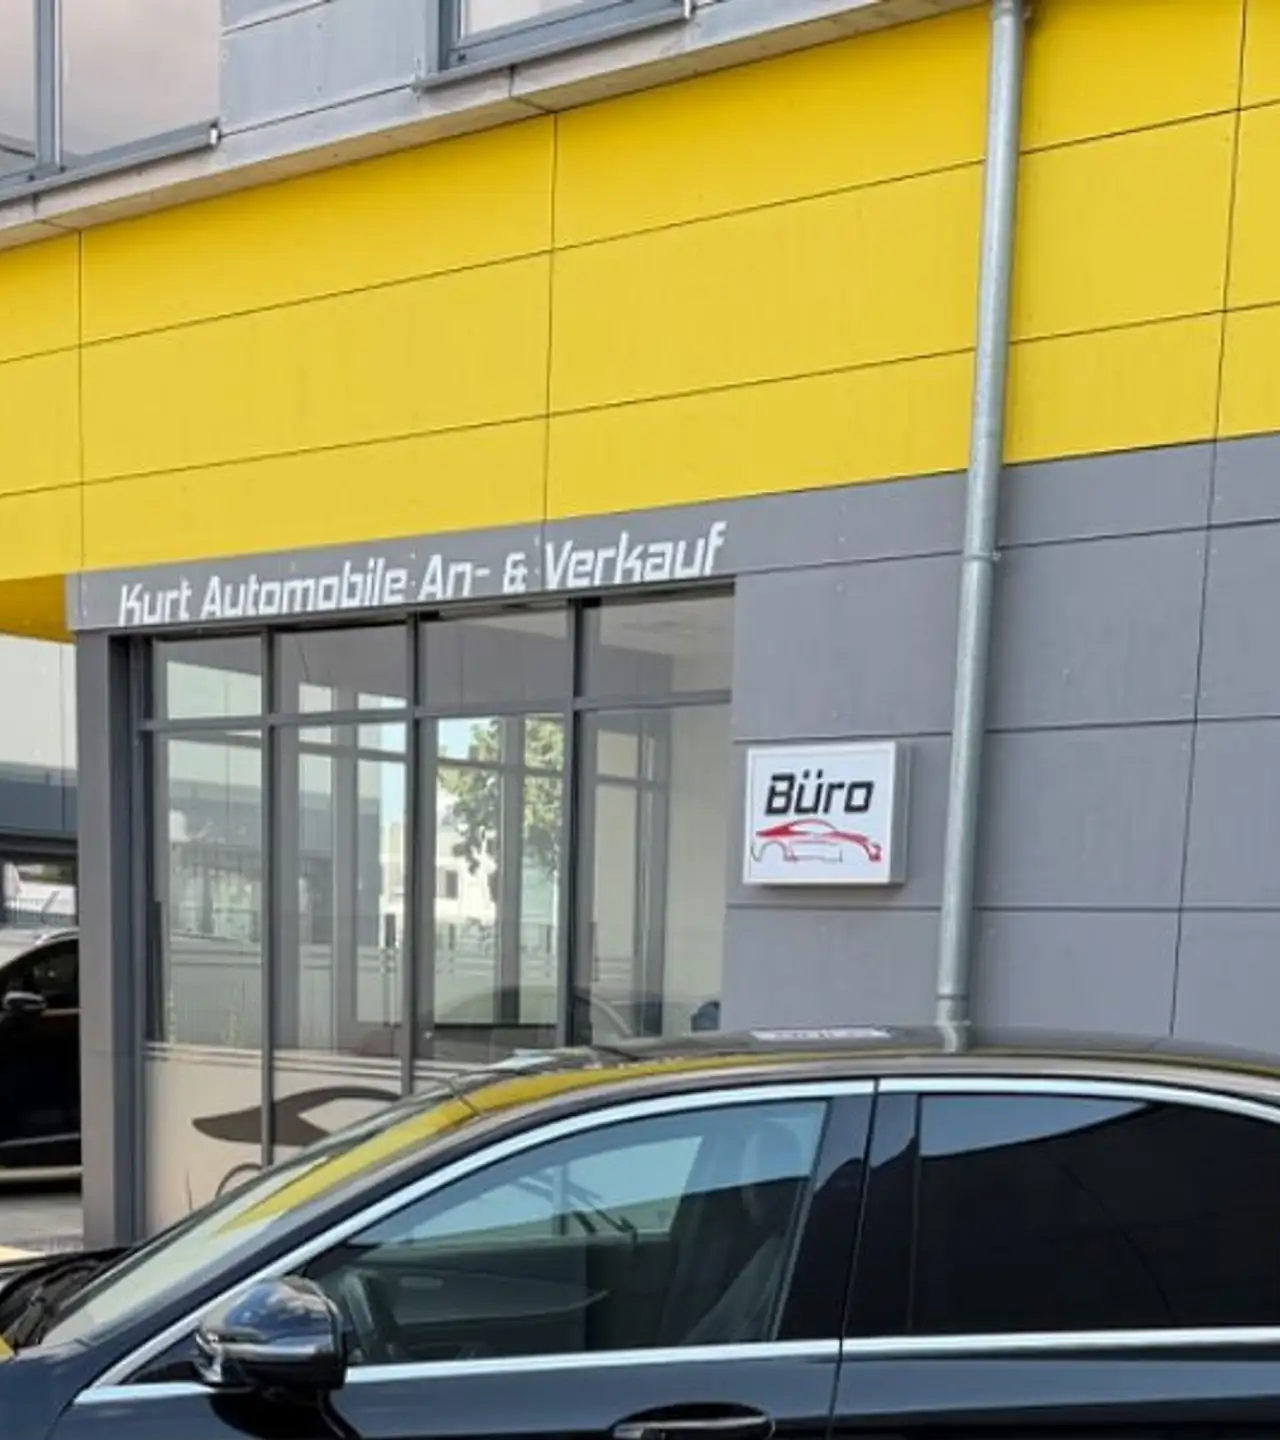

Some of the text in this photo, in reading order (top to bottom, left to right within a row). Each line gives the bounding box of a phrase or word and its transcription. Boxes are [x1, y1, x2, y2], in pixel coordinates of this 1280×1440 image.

[118, 520, 727, 627] Kurt Automobile An- & Verkauf
[765, 769, 874, 816] Büro
